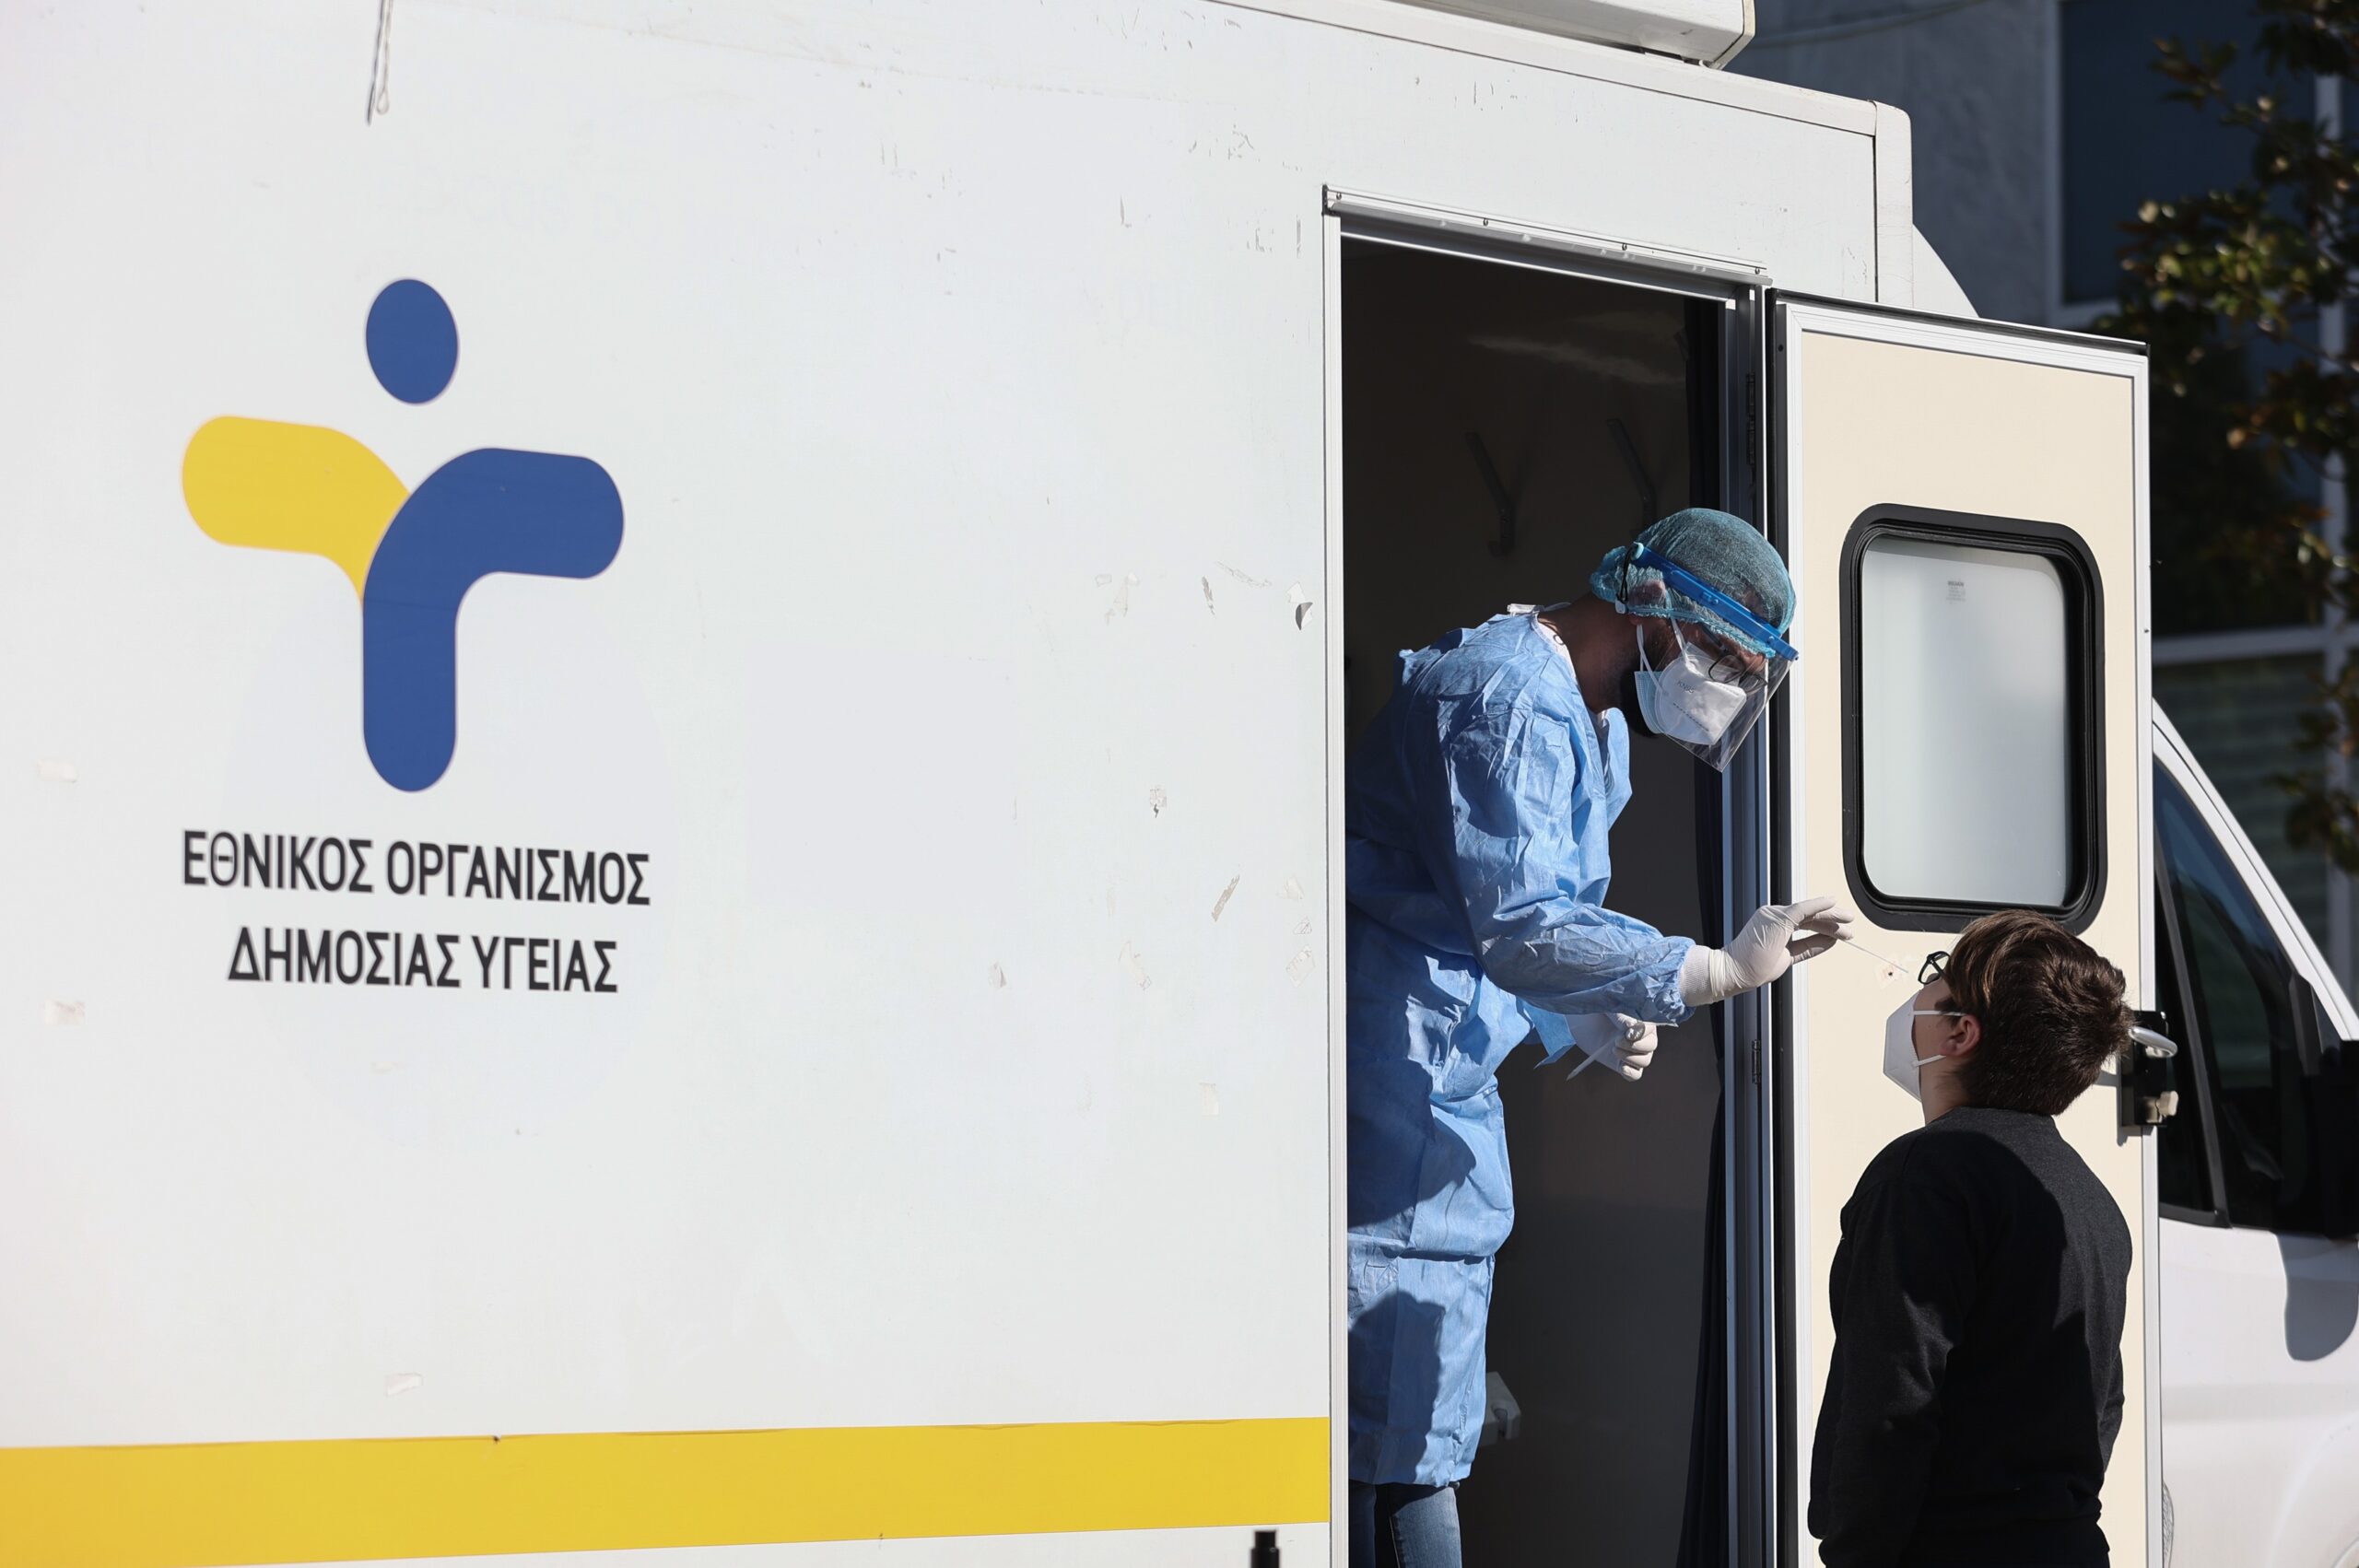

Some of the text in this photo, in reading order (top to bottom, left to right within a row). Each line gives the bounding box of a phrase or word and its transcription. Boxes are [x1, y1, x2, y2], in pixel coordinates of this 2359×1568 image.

[183, 830, 651, 906] ΕΘΝΙΚΟΣ ΟΡΓΑΝΙΣΜΟΣ
[228, 926, 617, 993] ΔΗΜΟΣΙΑΣ ΥΓΕΙΑΣ
